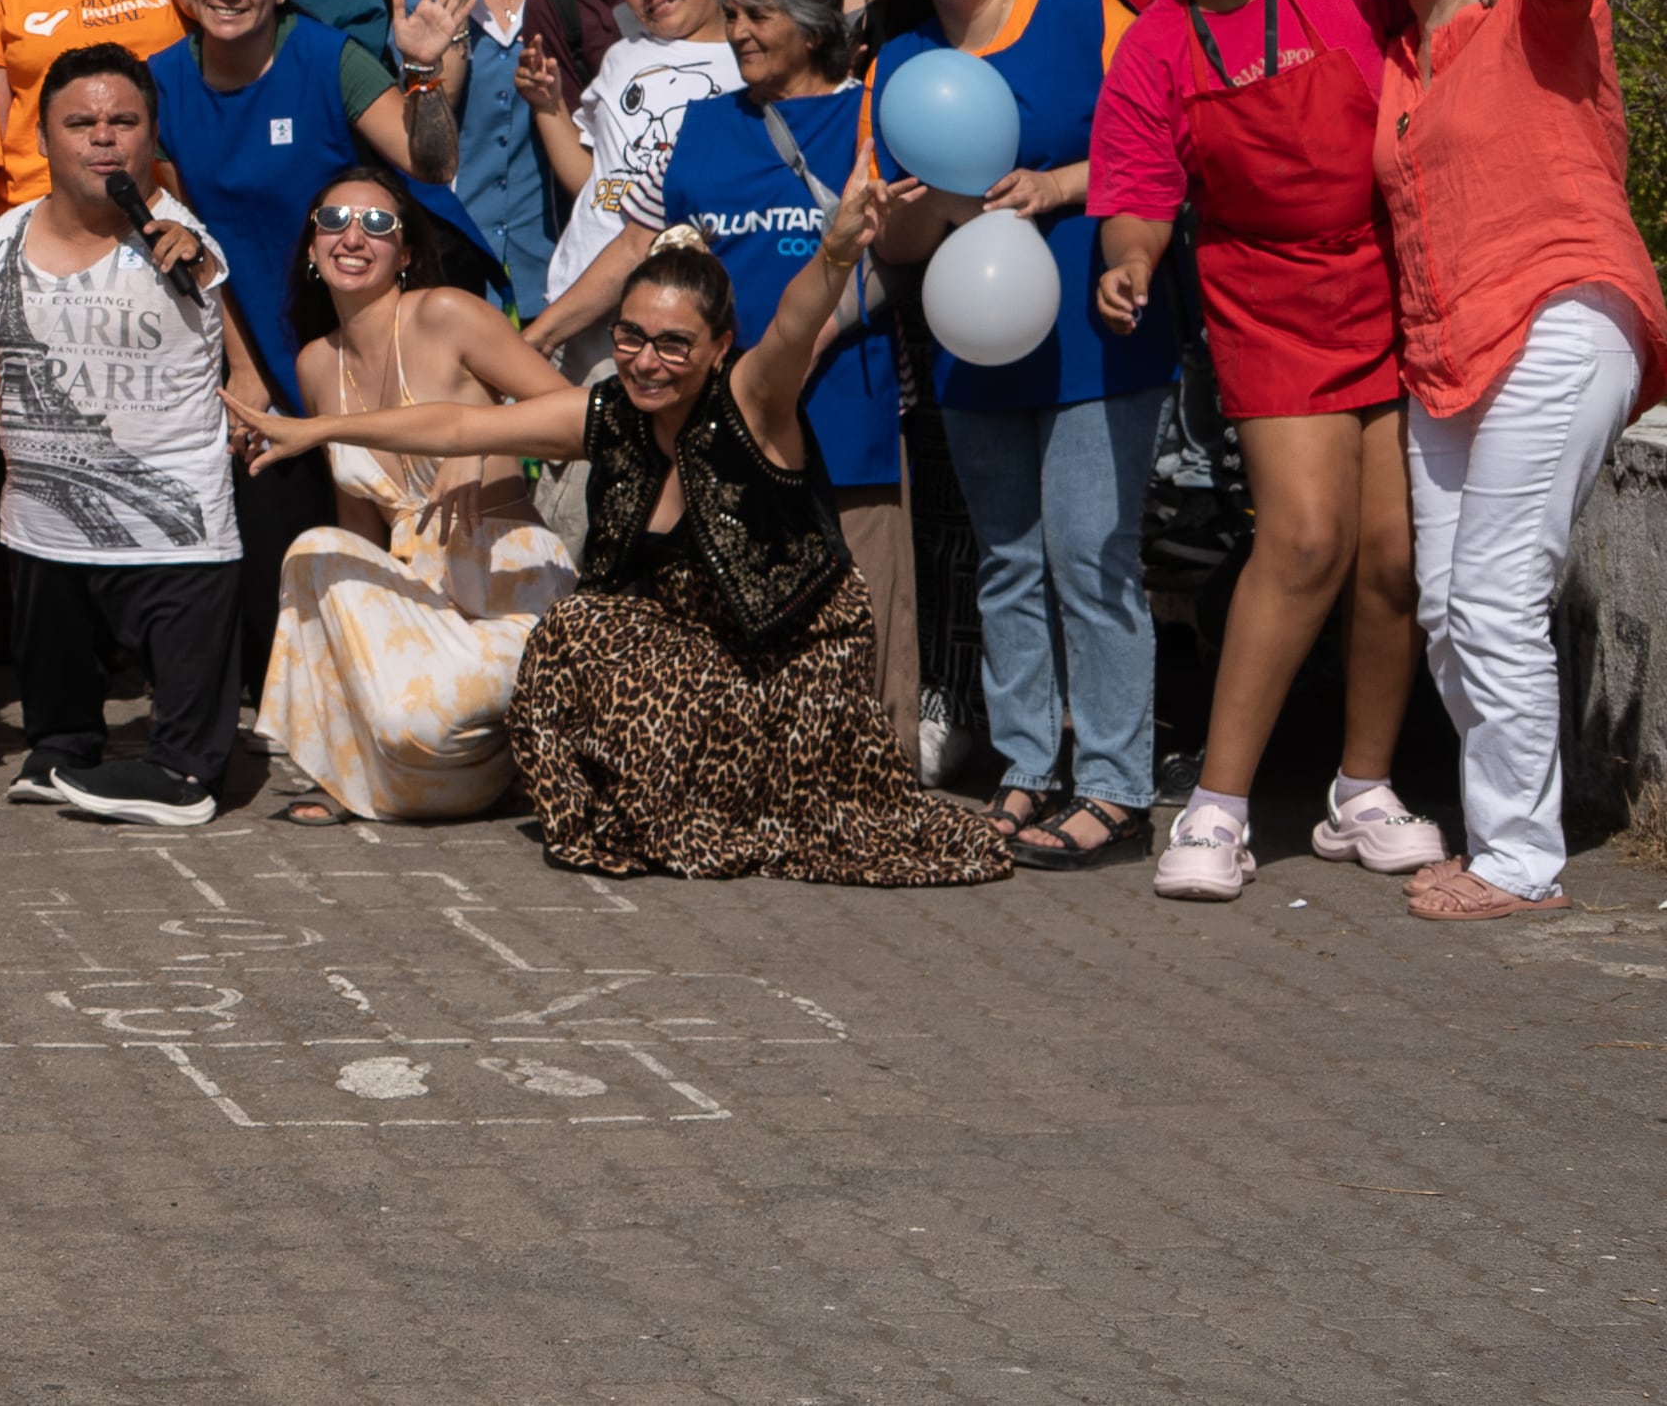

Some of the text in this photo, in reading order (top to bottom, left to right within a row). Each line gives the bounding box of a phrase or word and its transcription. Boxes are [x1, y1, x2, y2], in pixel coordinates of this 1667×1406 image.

[51, 295, 136, 308] EXCHANGE
[82, 346, 149, 360] EXCHANGE
[42, 357, 182, 403] PARIS
